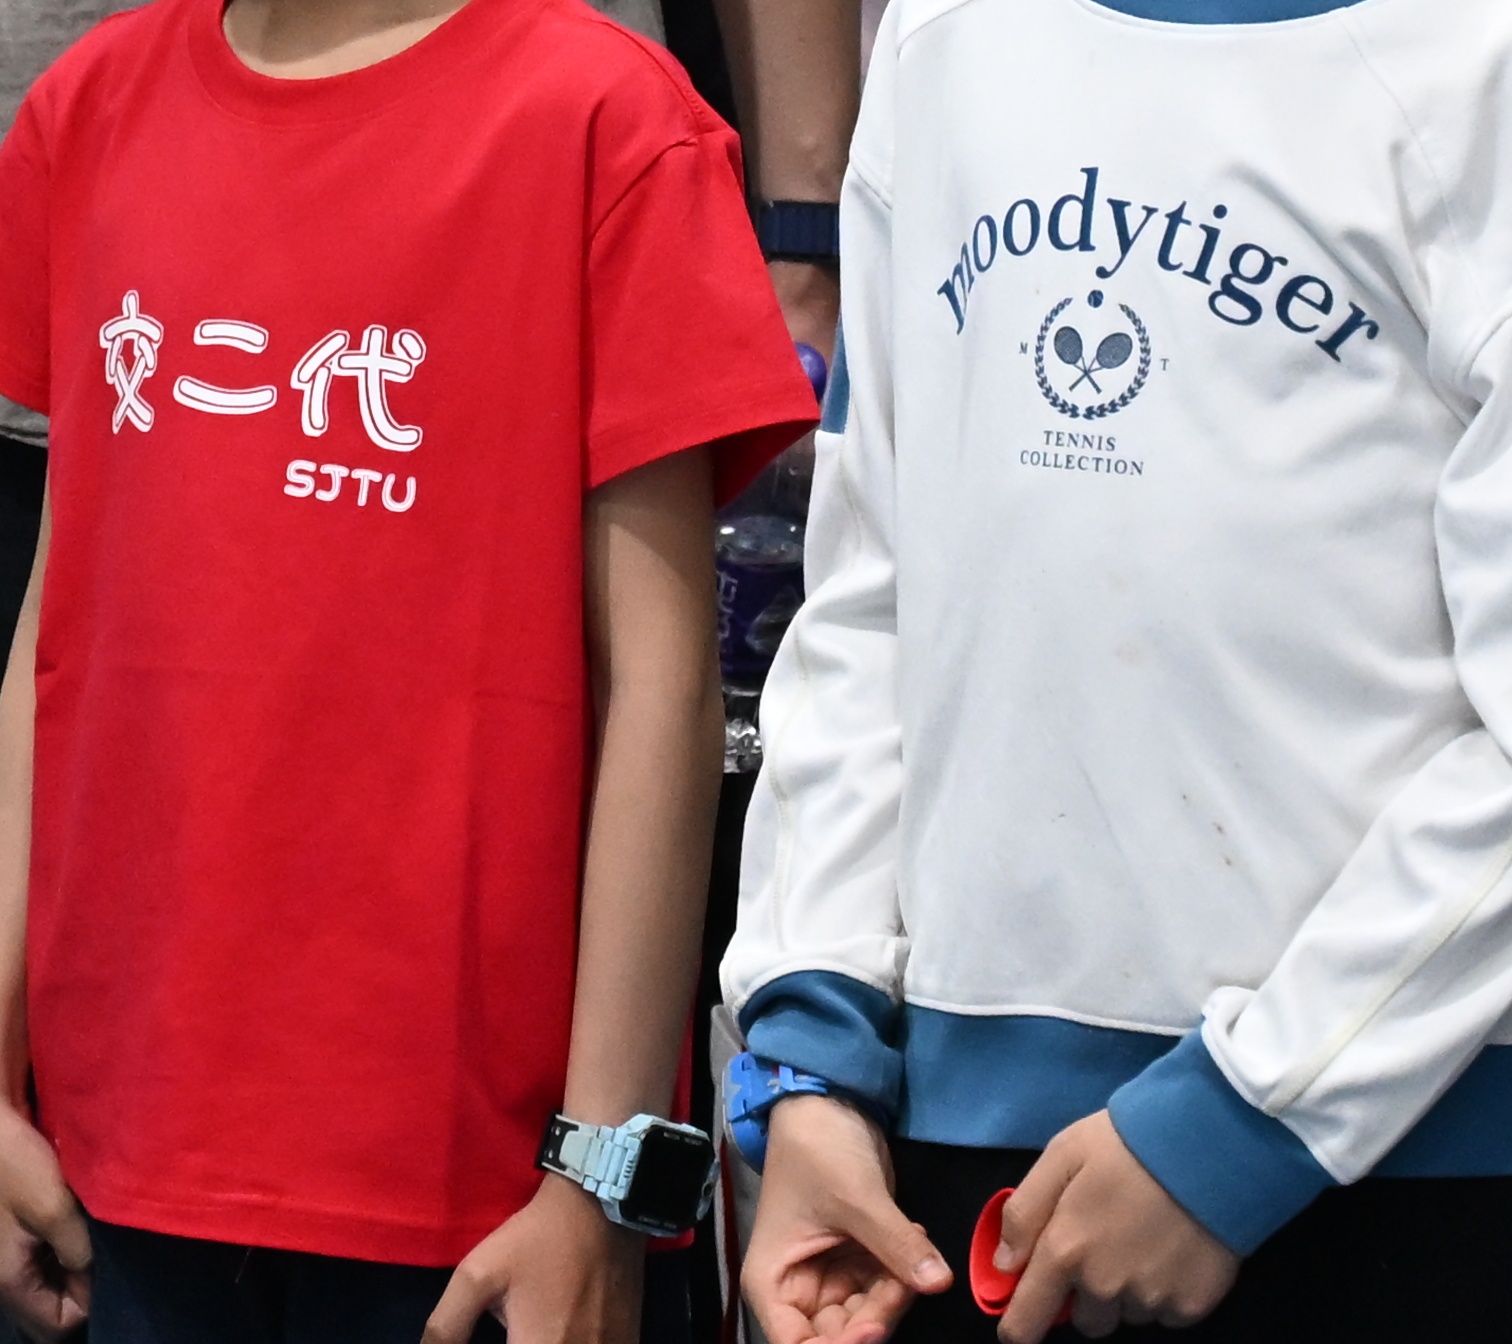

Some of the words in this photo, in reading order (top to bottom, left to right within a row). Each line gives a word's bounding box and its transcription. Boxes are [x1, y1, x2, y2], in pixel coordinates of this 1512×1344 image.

[936, 166, 1380, 363] moodytiger
[1043, 429, 1117, 452] TENNIS
[1019, 449, 1145, 476] COLLECTION
[284, 459, 417, 512] SJTU
